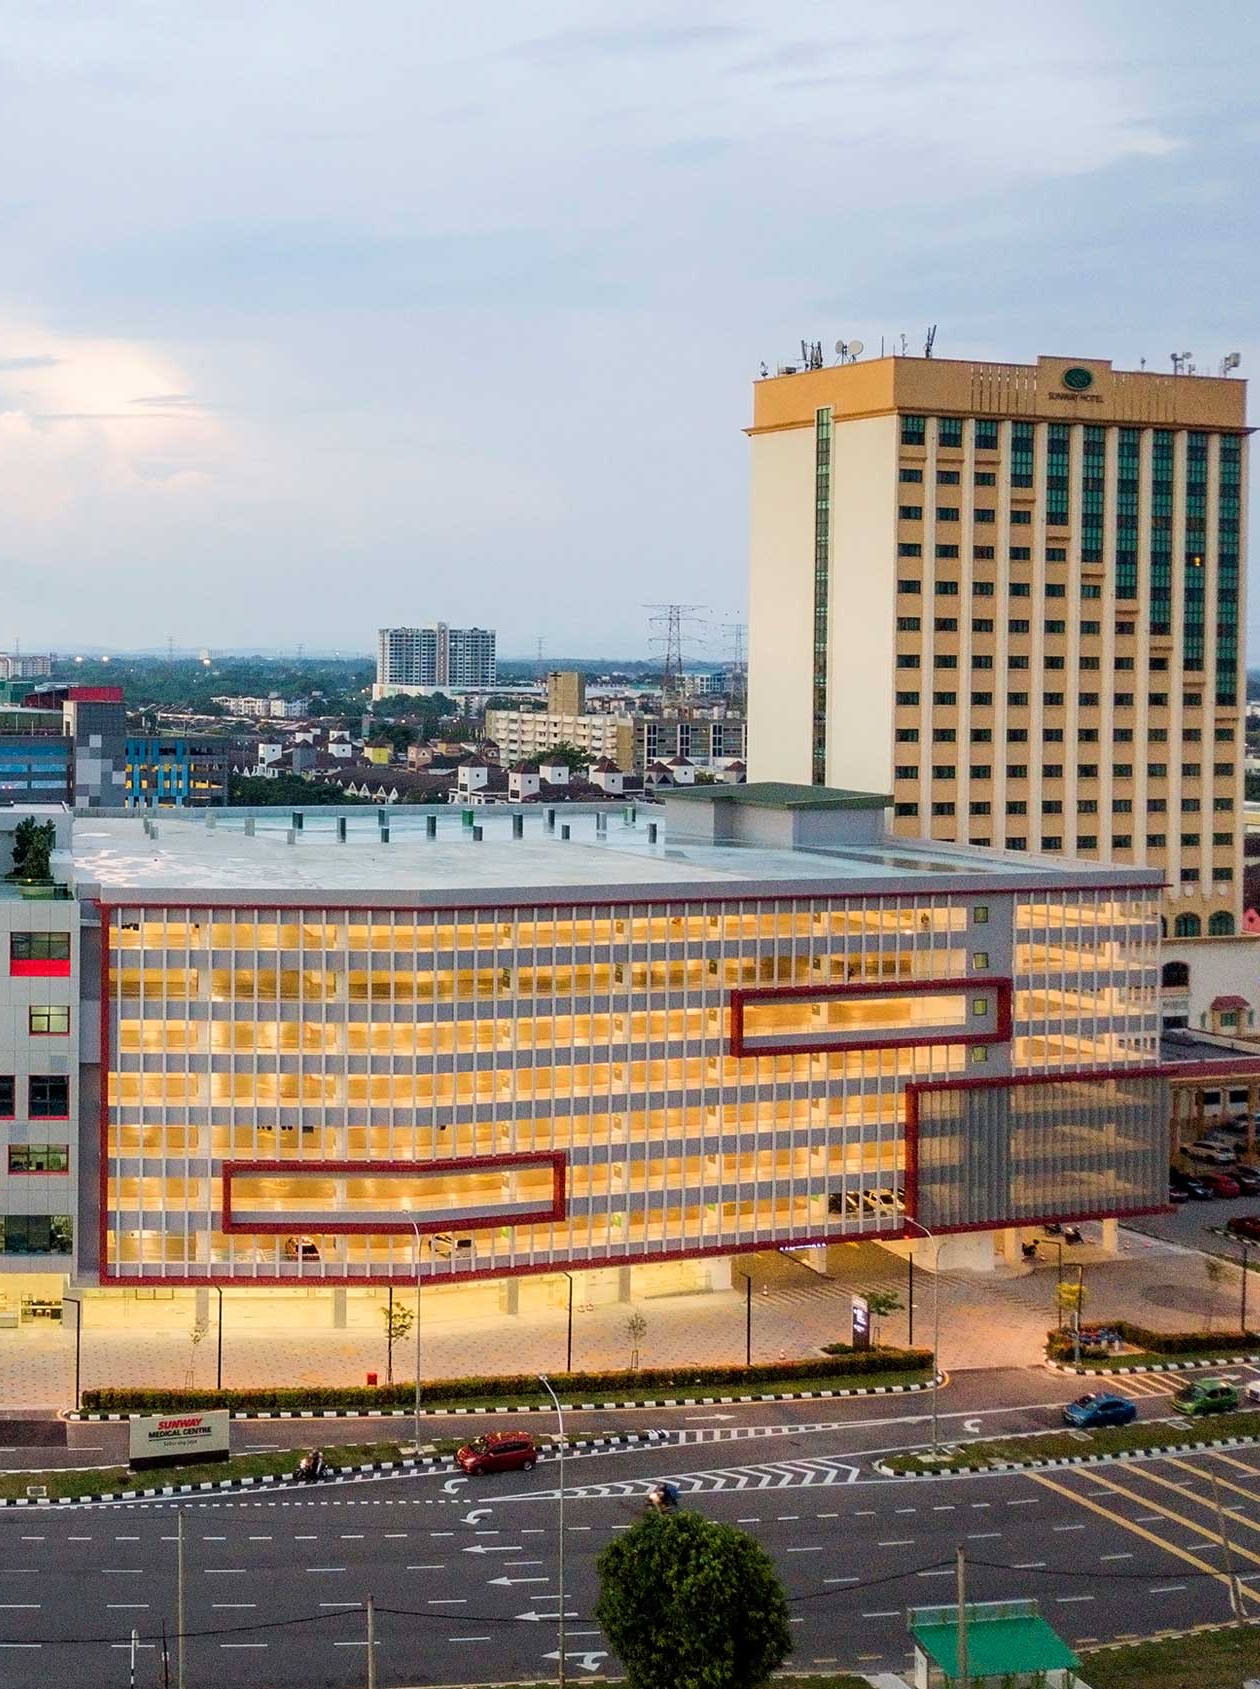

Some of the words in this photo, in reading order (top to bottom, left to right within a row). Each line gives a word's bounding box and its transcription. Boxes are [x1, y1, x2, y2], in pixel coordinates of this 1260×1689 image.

[1049, 392, 1078, 401] SUNWAY
[1080, 394, 1104, 403] HOTEL
[158, 1419, 202, 1430] SUNWAY
[148, 1429, 182, 1439] MEDICAL
[183, 1426, 212, 1436] CENTRE
